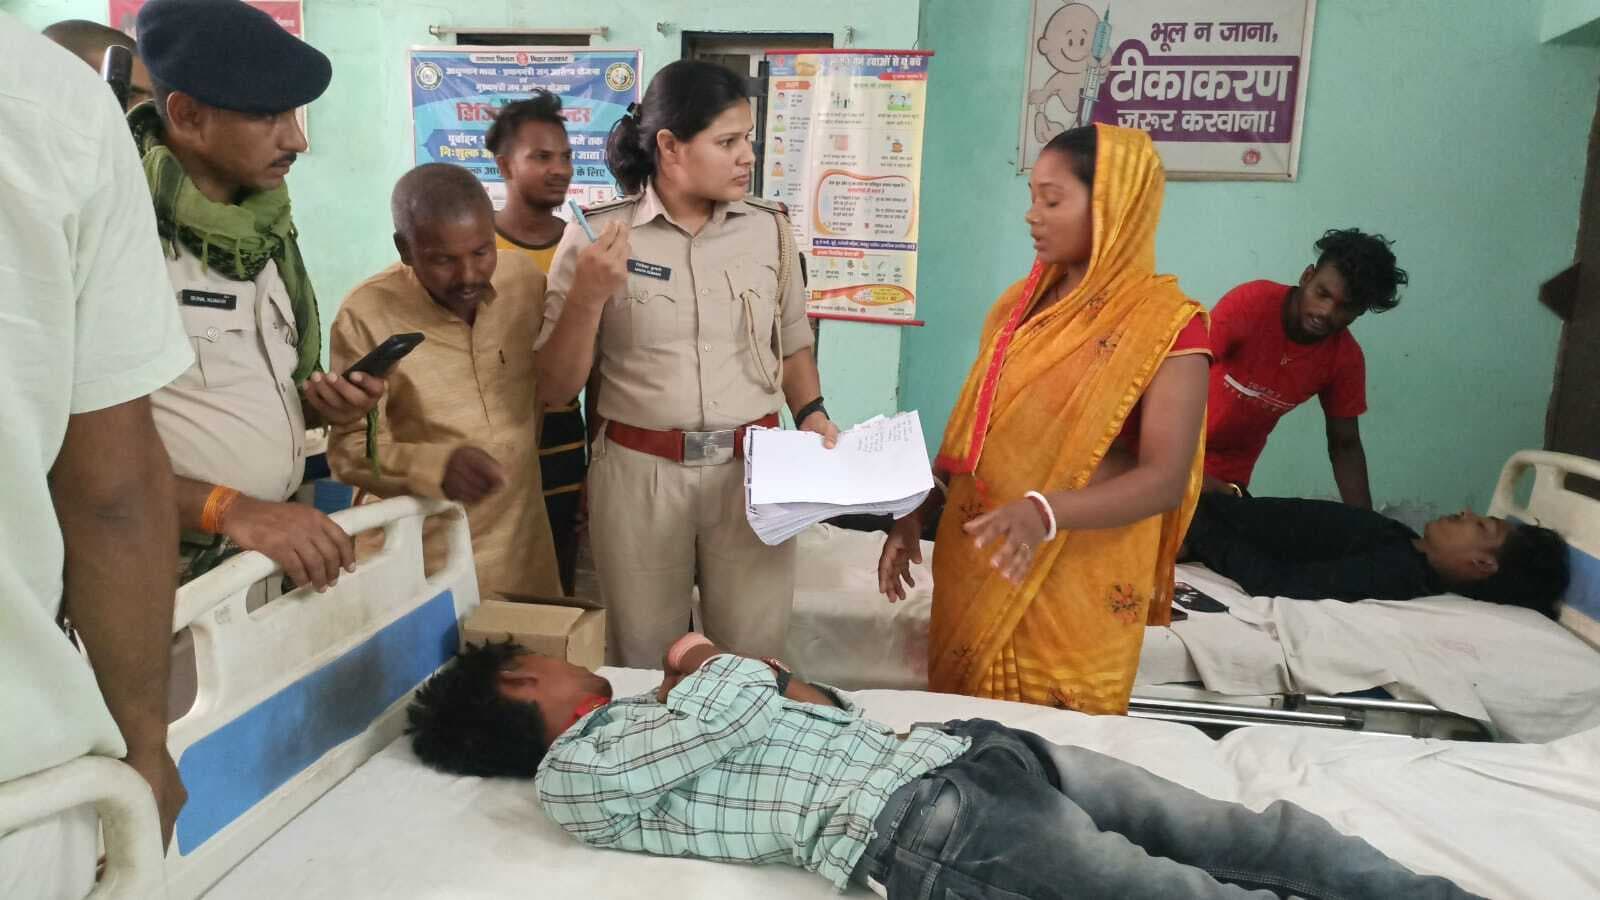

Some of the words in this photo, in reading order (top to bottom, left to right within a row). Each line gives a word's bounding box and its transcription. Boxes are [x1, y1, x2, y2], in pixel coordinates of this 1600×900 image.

[1151, 22, 1188, 51] भूल
[1194, 22, 1213, 42] न
[1219, 22, 1279, 43] जाना,
[1110, 48, 1293, 102] टीकाकरण
[1182, 110, 1276, 133] करवाना!
